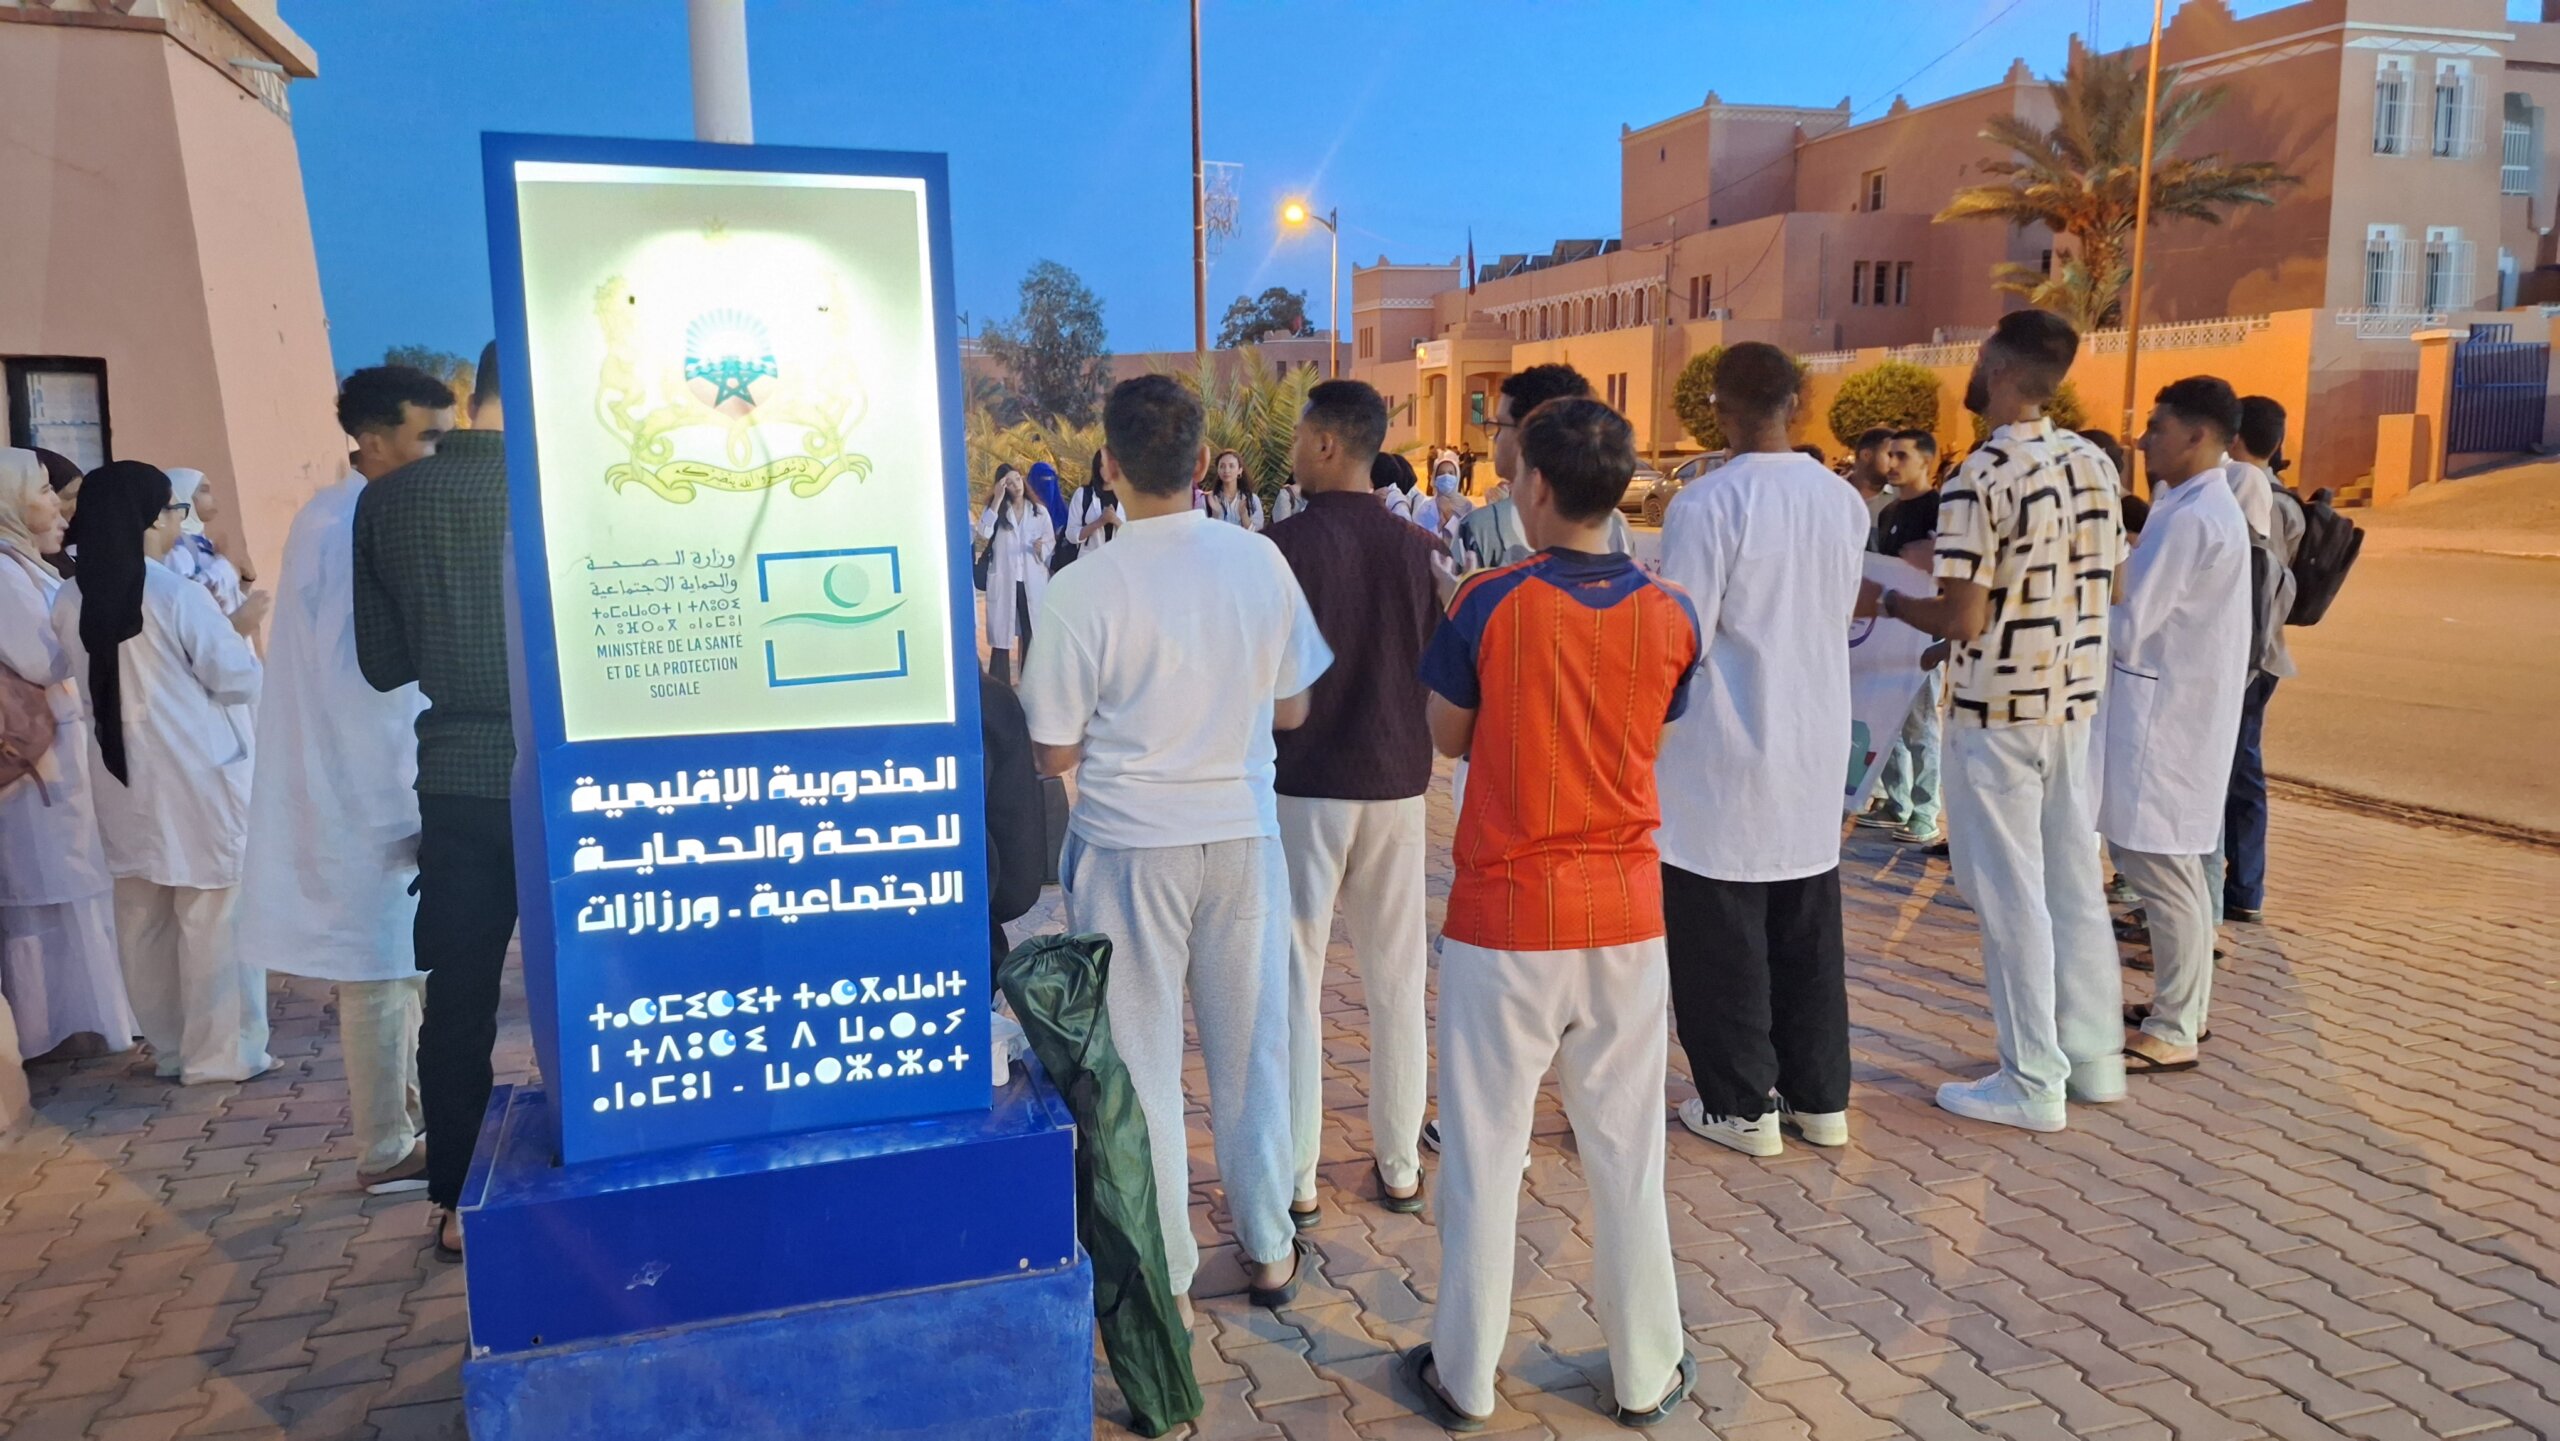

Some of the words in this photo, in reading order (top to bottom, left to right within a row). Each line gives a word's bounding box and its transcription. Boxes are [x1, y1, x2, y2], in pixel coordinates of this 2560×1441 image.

[690, 547, 736, 570] وزارة
[589, 576, 675, 600] الاجتماعية
[680, 572, 738, 595] والحماية
[596, 638, 665, 659] MINISTÈRE
[667, 638, 684, 654] DE
[687, 637, 702, 653] LA
[704, 632, 744, 651] SANTÉ
[606, 665, 622, 681] ET
[624, 664, 642, 679] DE
[644, 662, 661, 678] LA
[663, 656, 739, 676] PROTECTION
[649, 681, 701, 699] SOCIALE
[571, 766, 760, 819] الإقليمية
[768, 756, 957, 807] المندوبية
[813, 813, 961, 856] للصحة
[749, 871, 965, 925] الاجتماعية
[577, 890, 721, 936] ورزازات
